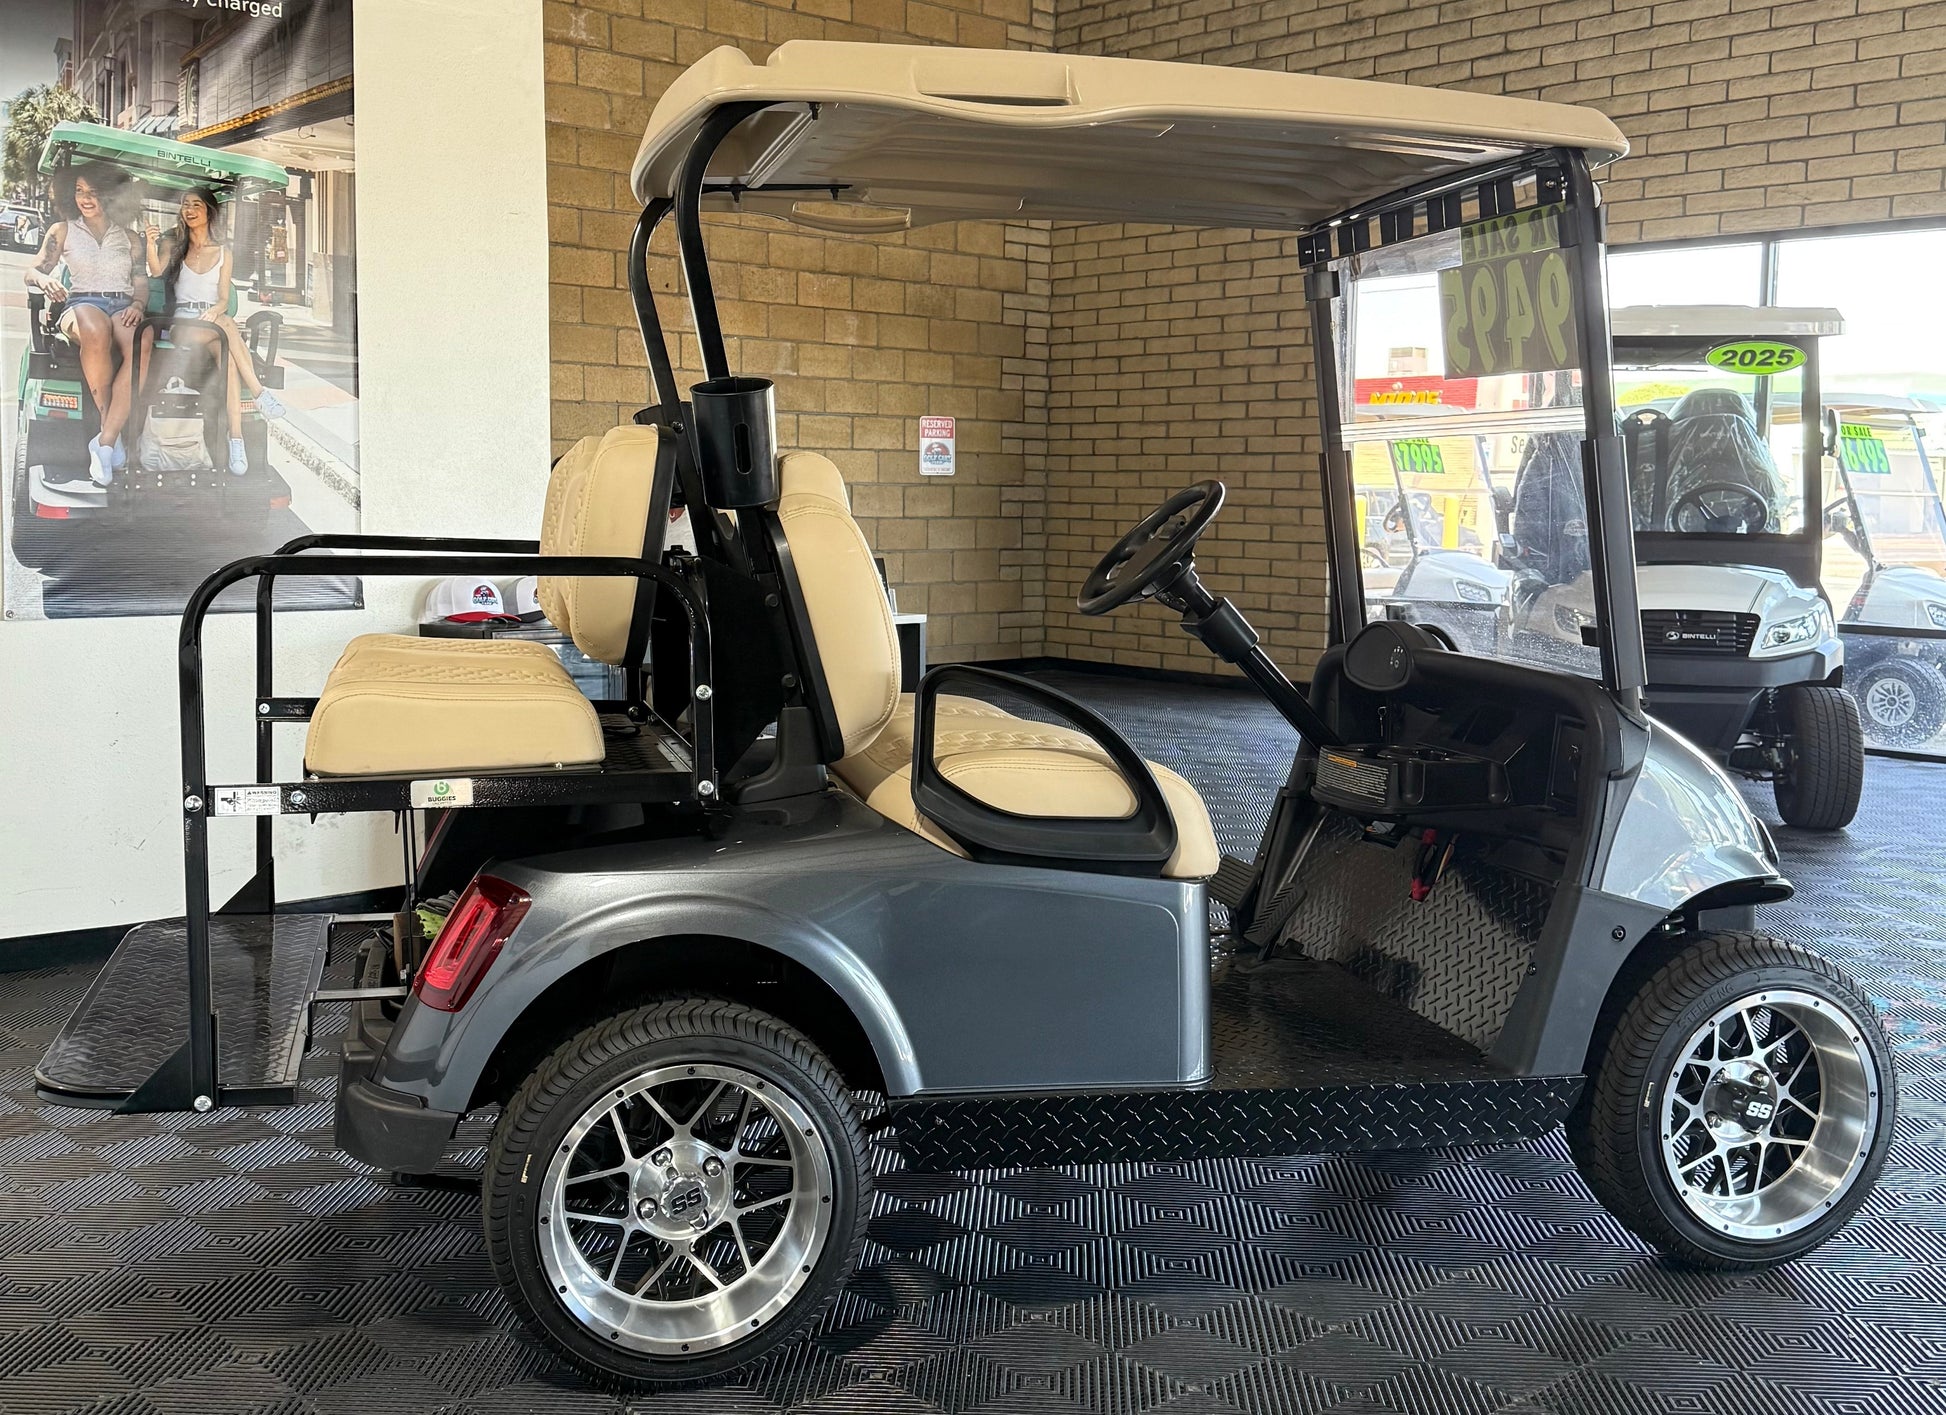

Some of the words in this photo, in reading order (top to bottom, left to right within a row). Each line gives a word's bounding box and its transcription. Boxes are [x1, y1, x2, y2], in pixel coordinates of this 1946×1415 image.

[157, 149, 211, 167] BINTELLI
[1718, 349, 1796, 367] 2025
[921, 419, 953, 429] RESERVED
[924, 428, 951, 437] PARKING
[1841, 425, 1851, 436] OR
[1854, 426, 1872, 438] SALE
[1746, 1101, 1773, 1119] SS
[671, 1187, 702, 1215] SS
